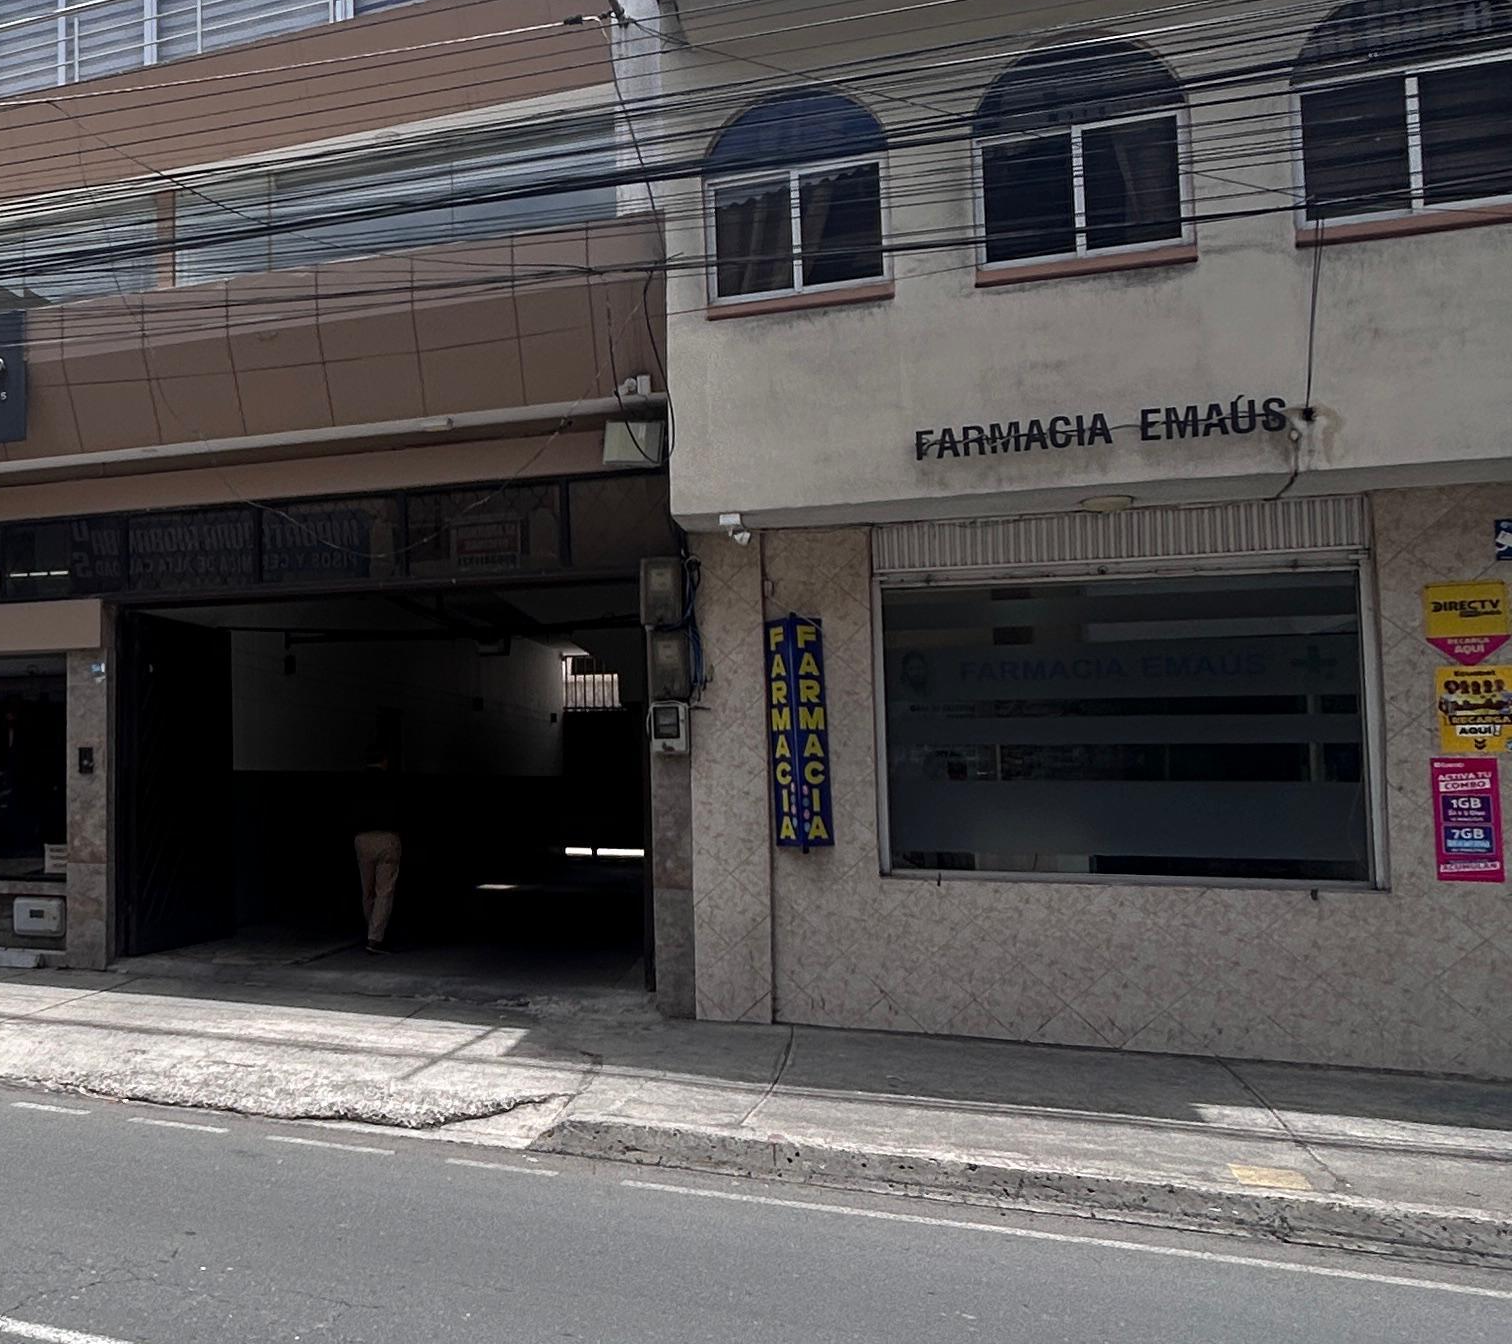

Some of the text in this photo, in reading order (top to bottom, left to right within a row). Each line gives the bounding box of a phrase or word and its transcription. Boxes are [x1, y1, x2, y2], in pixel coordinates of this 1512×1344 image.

[915, 395, 1287, 461] FARMACIA EMAÚS
[1431, 599, 1500, 612] DIRECTV
[959, 657, 1125, 682] FARMACIA
[769, 626, 796, 840] FARMACIA
[796, 624, 829, 840] FARMACIA
[1444, 780, 1486, 789] COMBO
[1451, 797, 1482, 809] 1GB
[1451, 828, 1484, 840] 7GB
